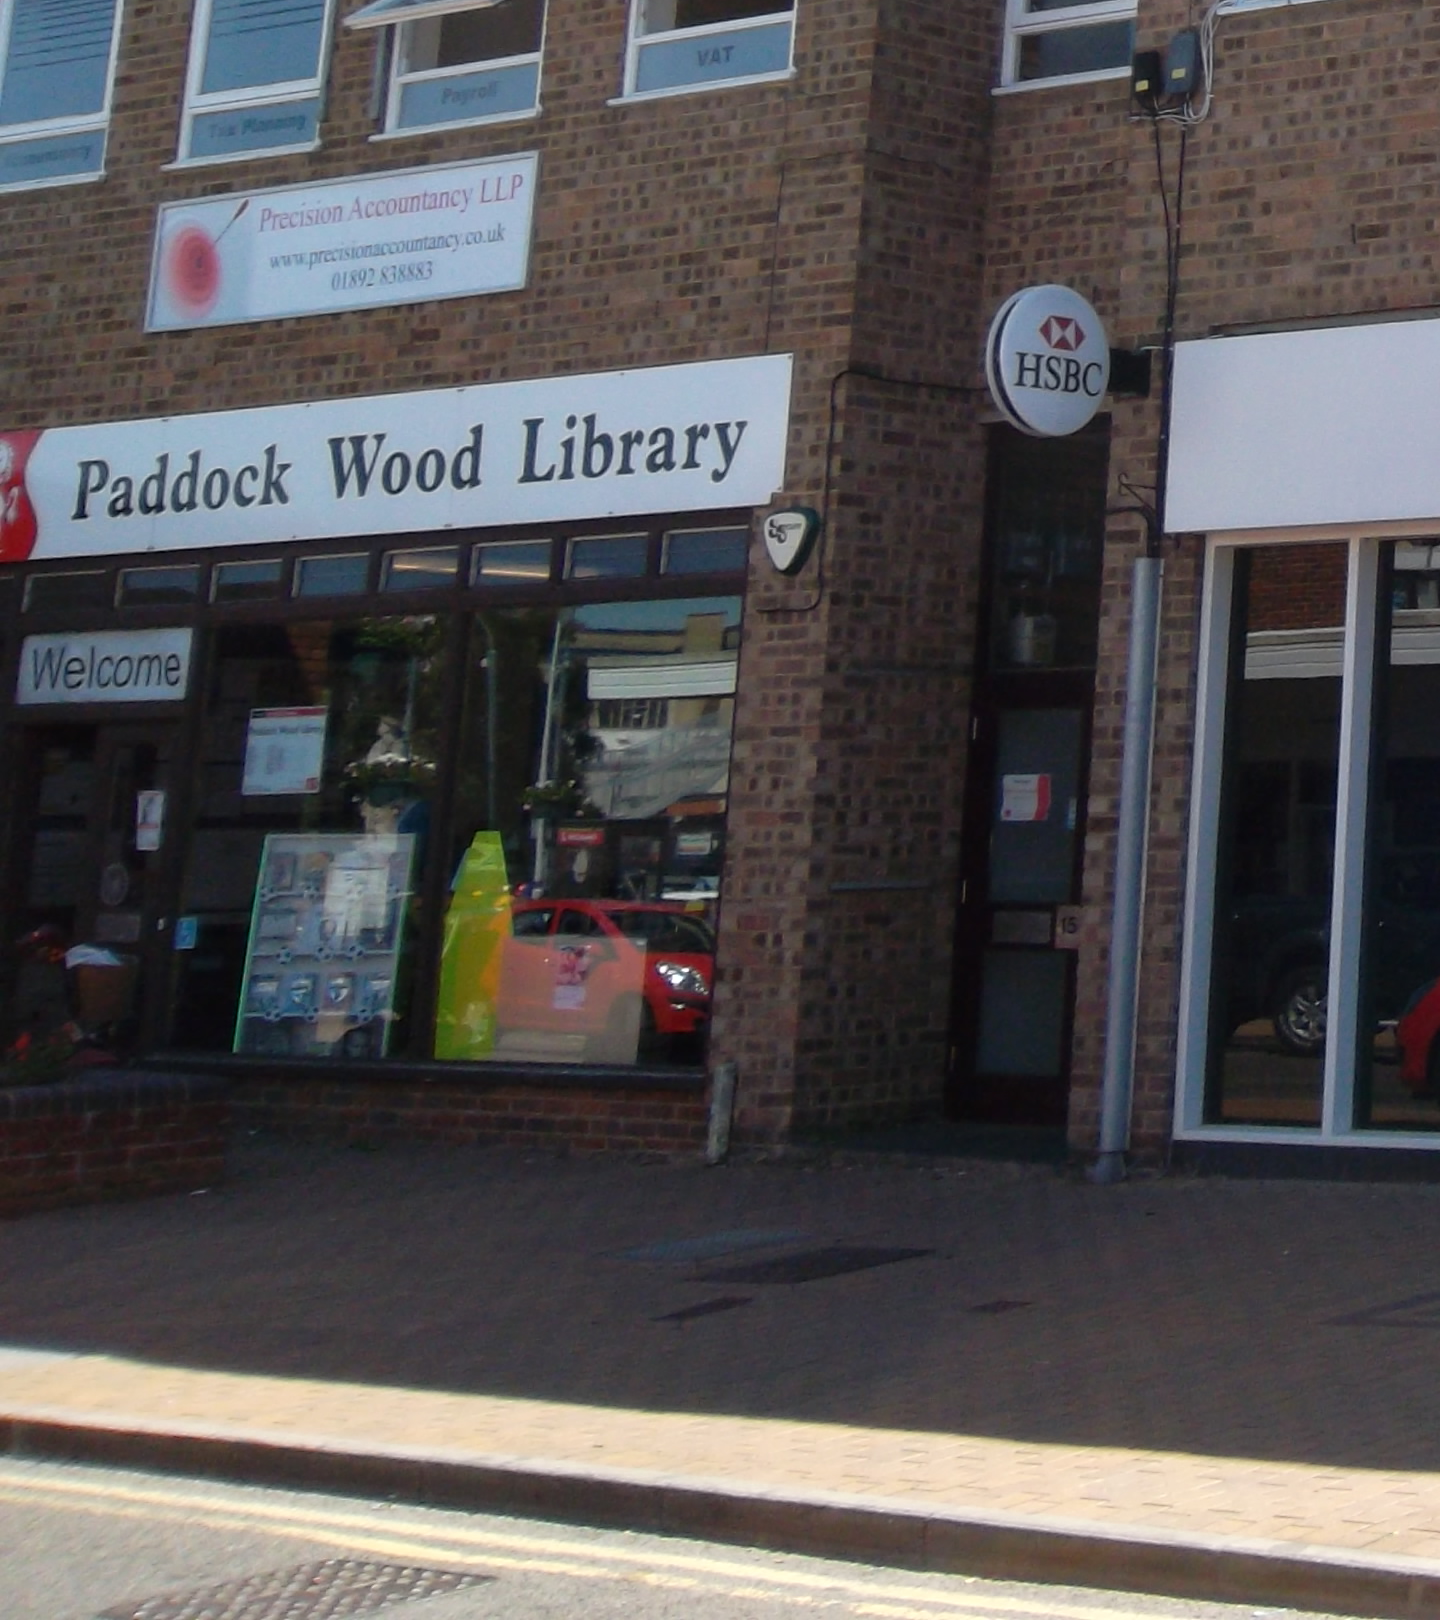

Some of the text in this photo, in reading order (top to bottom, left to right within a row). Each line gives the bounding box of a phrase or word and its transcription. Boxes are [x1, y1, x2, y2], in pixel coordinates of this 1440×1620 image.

[697, 45, 735, 67] VAT
[442, 81, 497, 107] Payroll
[258, 174, 524, 232] Precision Accountancy LLP
[269, 223, 506, 270] www.precisionaccountancy.co.uk
[331, 261, 433, 291] 01892 838883
[1013, 351, 1102, 397] HSBC
[71, 413, 748, 520] Paddock Wood Library
[32, 645, 181, 691] Welcome
